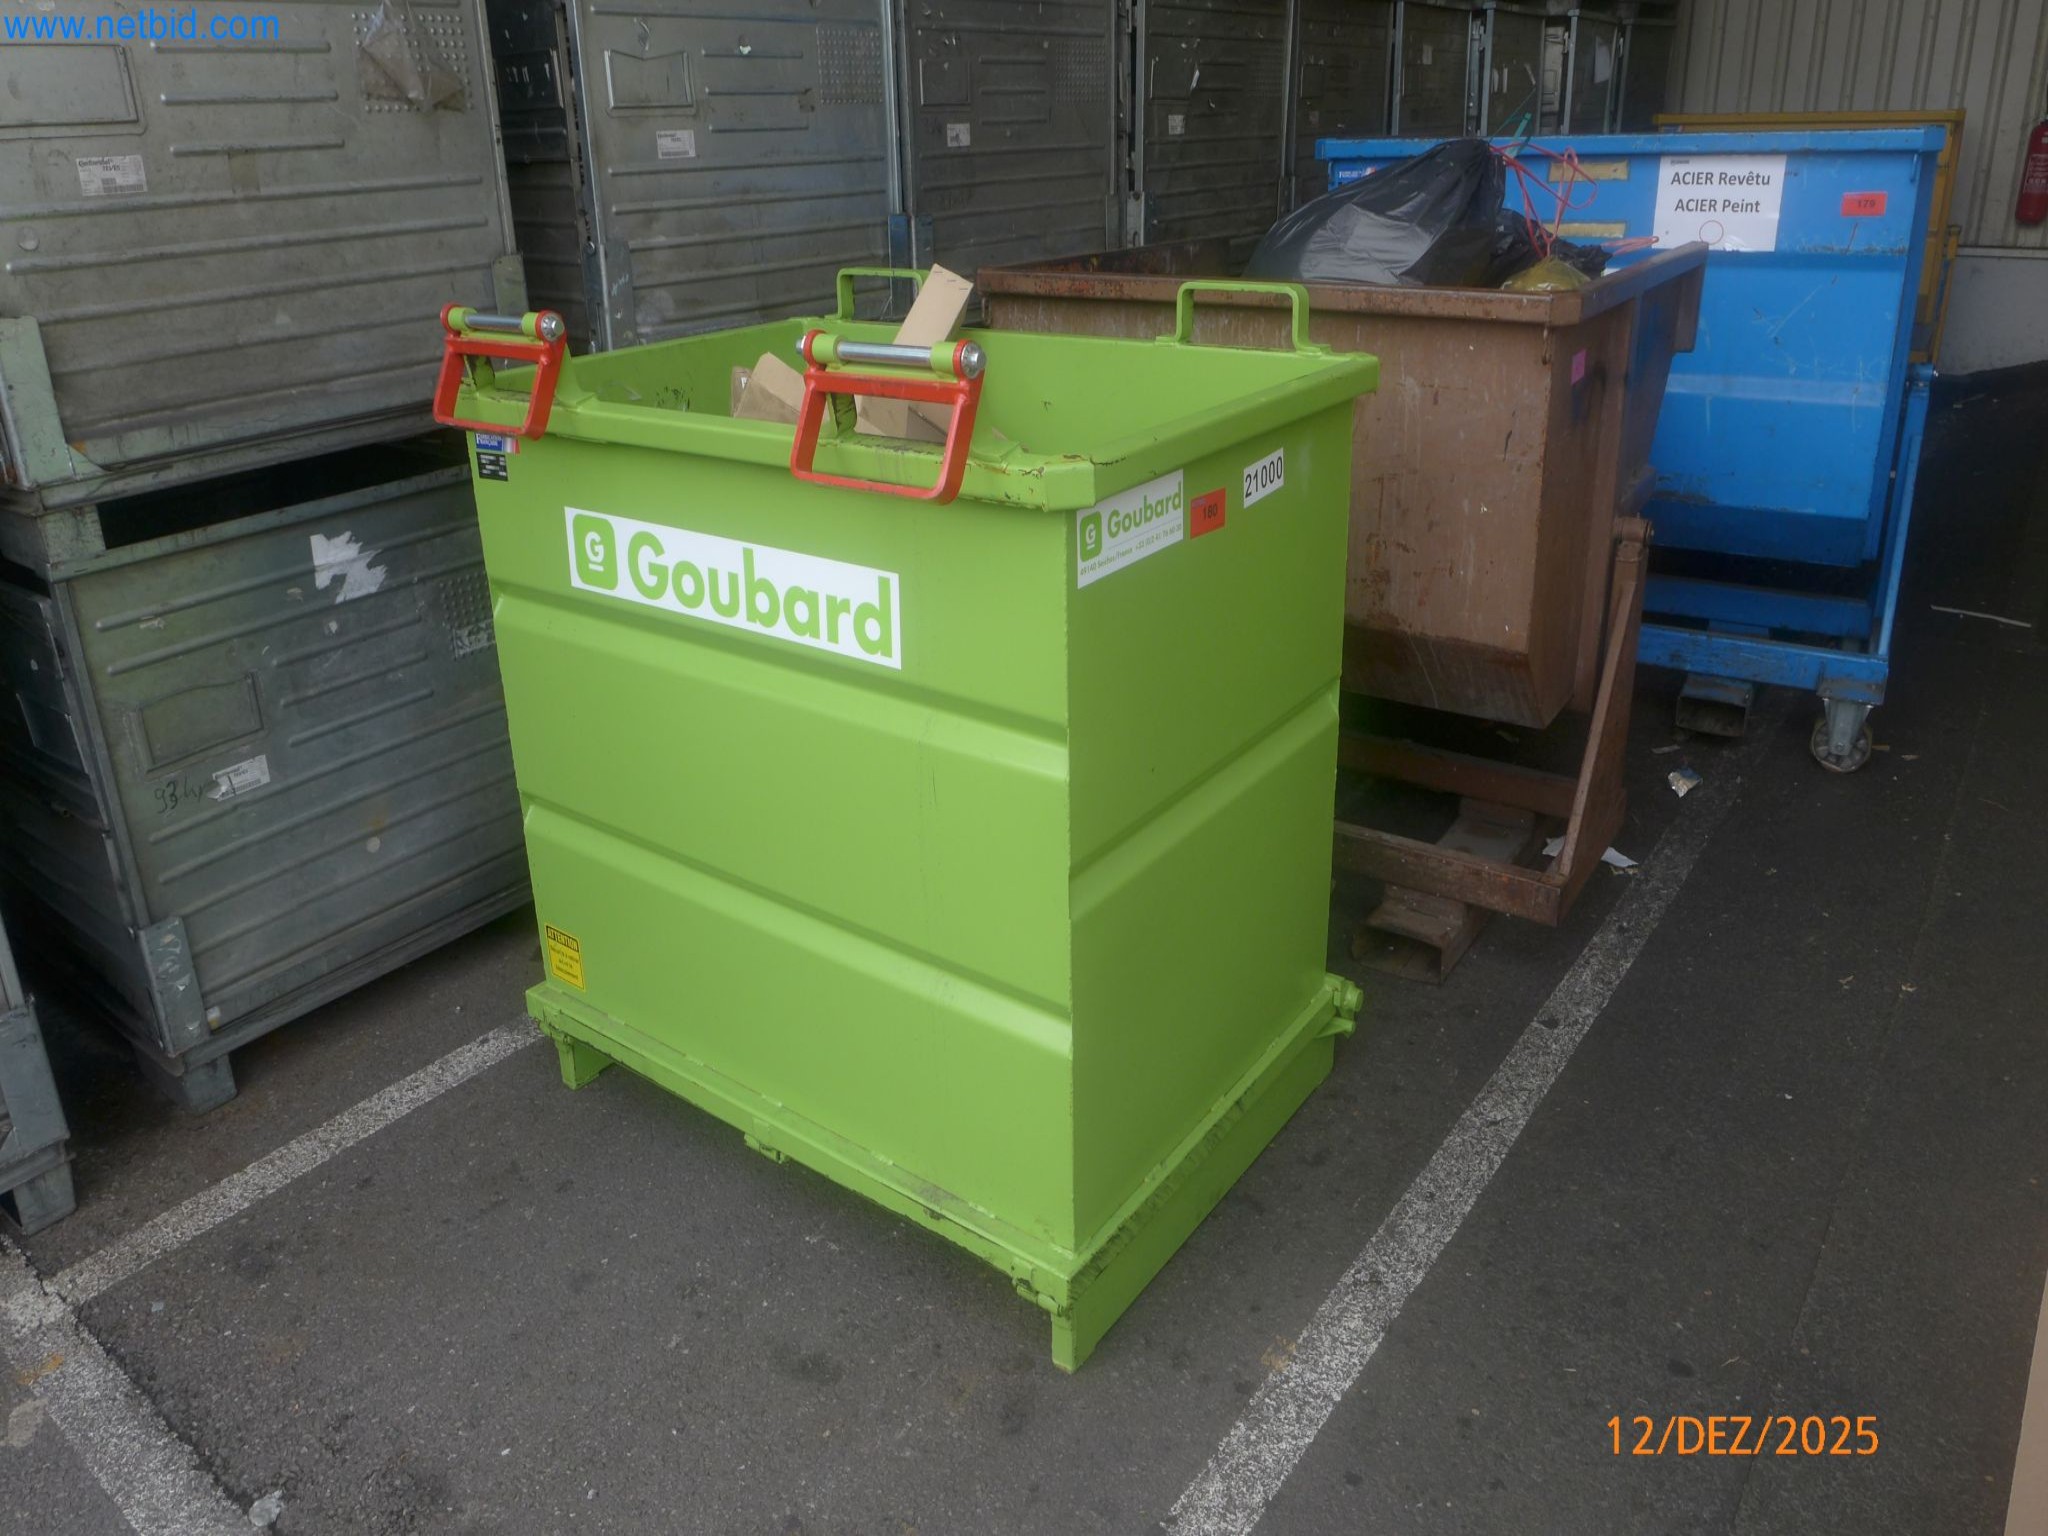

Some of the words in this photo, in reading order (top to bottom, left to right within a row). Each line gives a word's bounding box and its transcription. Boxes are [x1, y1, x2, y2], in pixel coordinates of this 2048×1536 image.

[1671, 172, 1713, 185] ACIER
[1718, 171, 1771, 186] Revêtu
[1675, 199, 1717, 212] ACIER
[1722, 199, 1760, 213] Peint
[1245, 455, 1283, 498] 21000
[1107, 480, 1182, 538] Goubard
[1203, 503, 1218, 520] 180
[627, 530, 893, 659] Goubard
